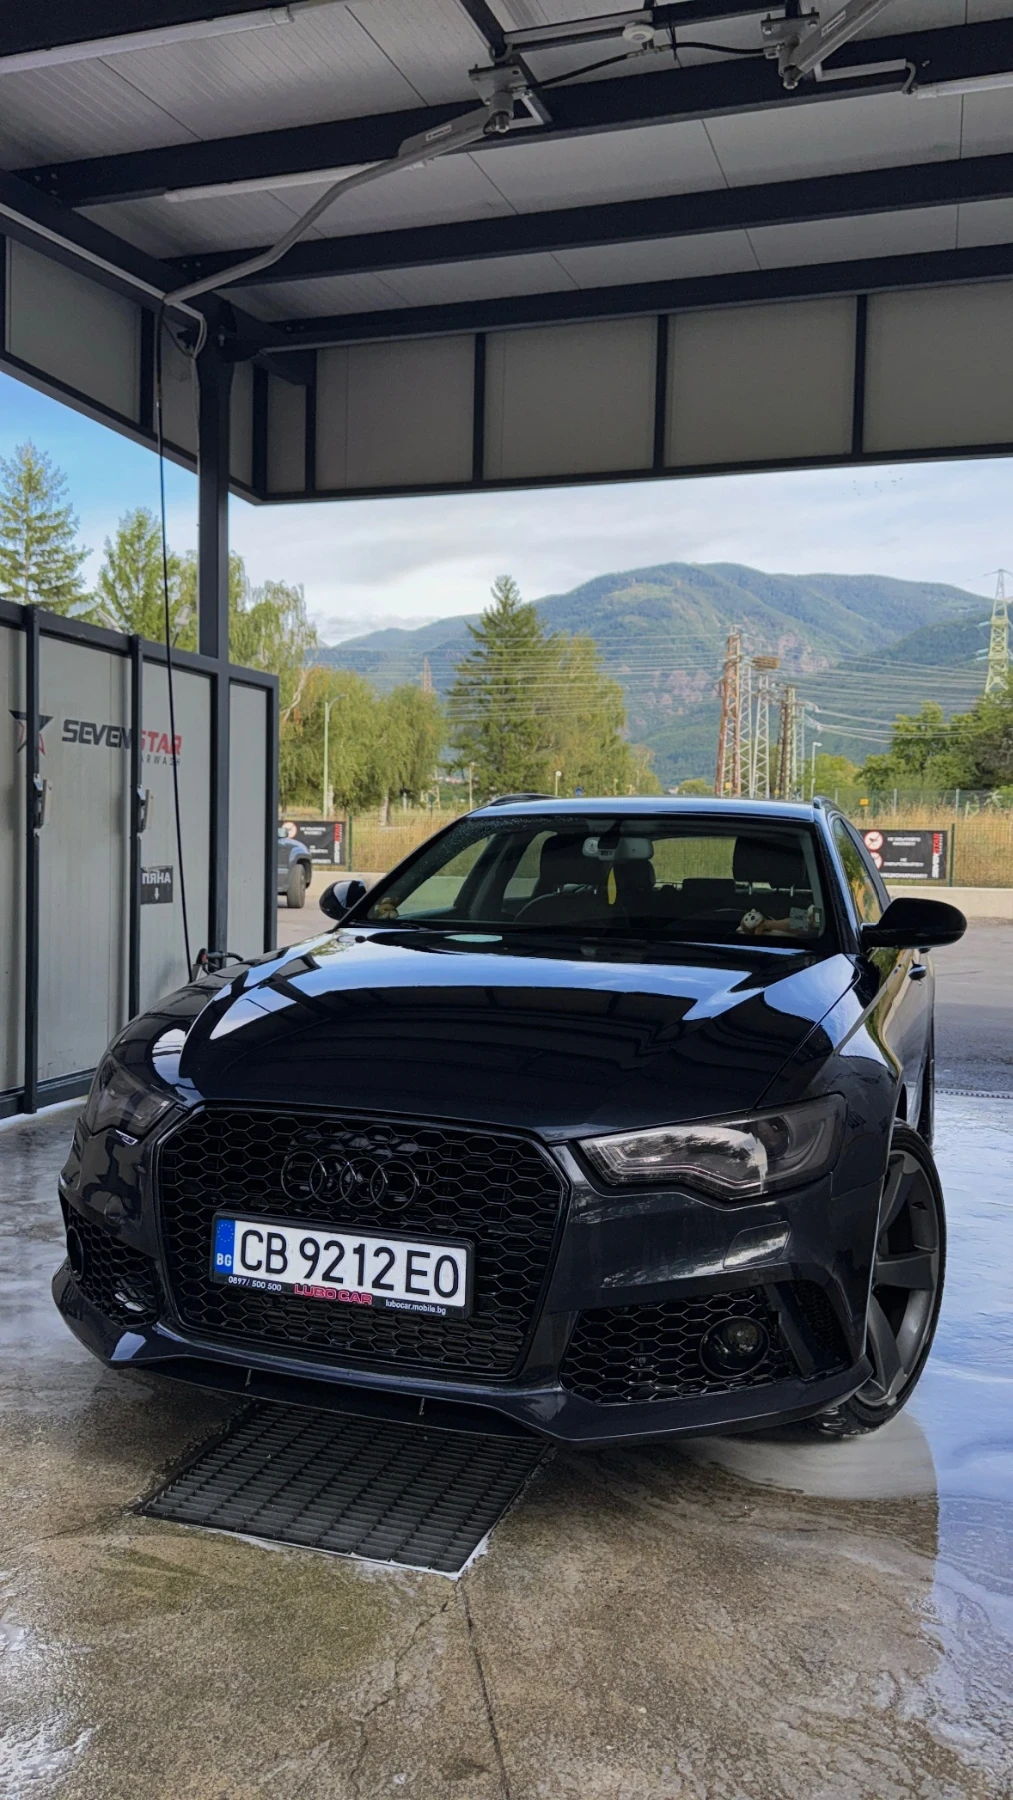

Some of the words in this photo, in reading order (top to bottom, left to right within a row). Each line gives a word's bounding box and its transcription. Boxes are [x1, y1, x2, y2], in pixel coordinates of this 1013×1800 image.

[62, 719, 132, 749] SEVEN
[142, 871, 171, 884] ПЯНА
[216, 1253, 232, 1267] BG
[240, 1229, 288, 1275] CB
[300, 1237, 396, 1291] 9212
[251, 1280, 266, 1289] 500
[267, 1283, 282, 1291] 500
[294, 1283, 337, 1300] LUBO
[338, 1290, 373, 1306] CAR
[385, 1299, 447, 1316] lubocar.mobile.bg
